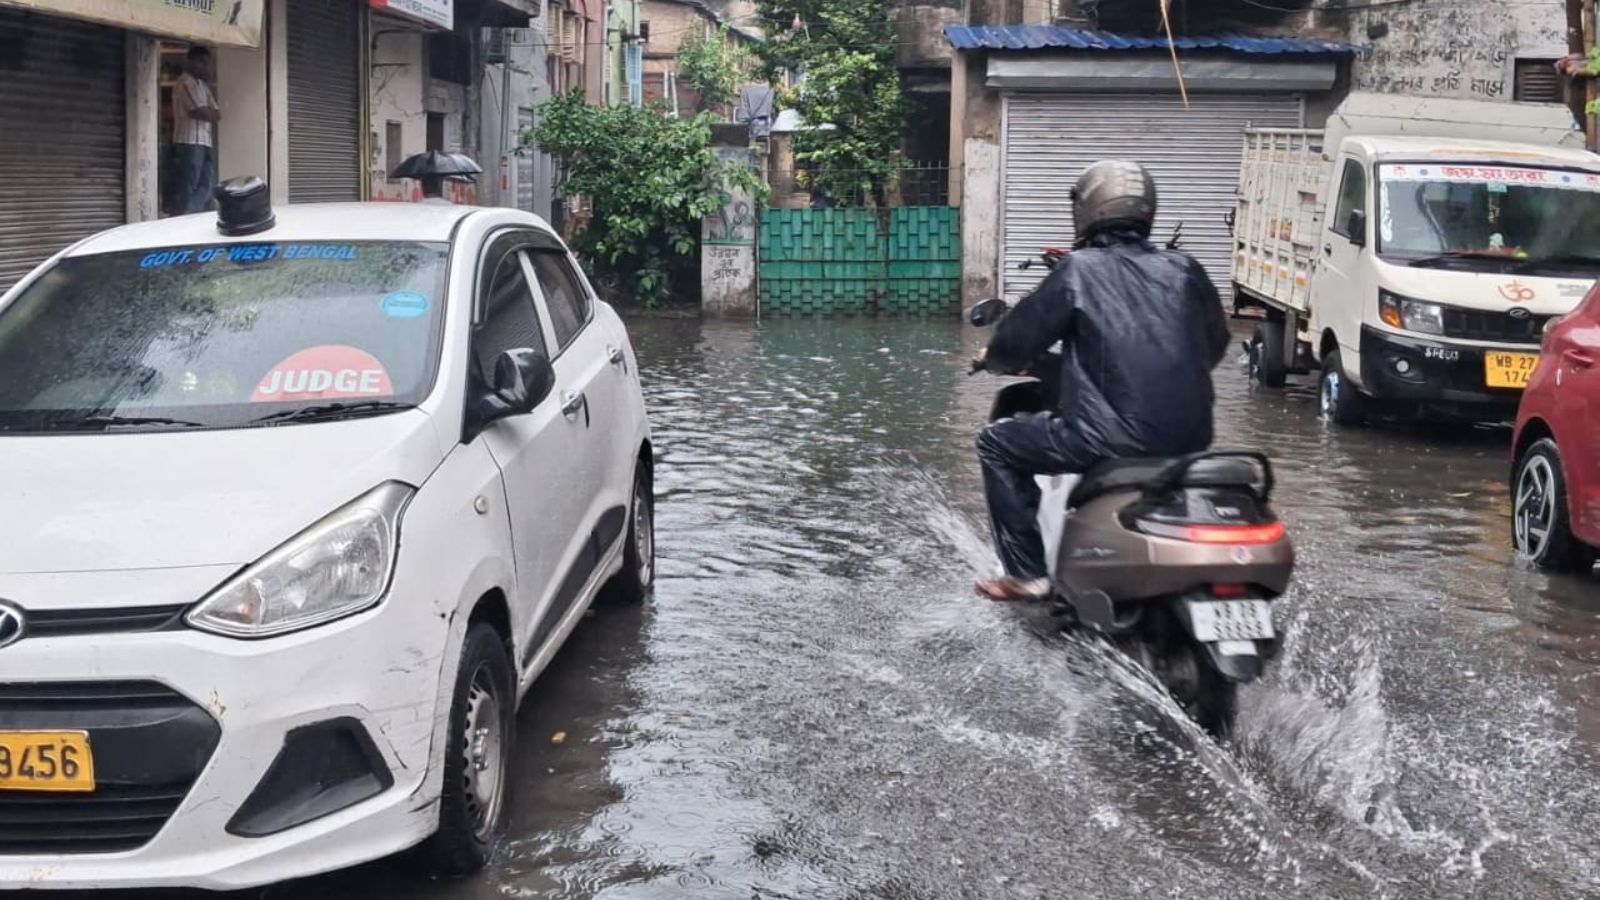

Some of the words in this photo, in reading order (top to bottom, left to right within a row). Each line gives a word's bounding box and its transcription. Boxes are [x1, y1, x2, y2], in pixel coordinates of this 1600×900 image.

[140, 251, 192, 269] GOVT.
[197, 248, 225, 263] OF
[226, 246, 280, 262] WEST
[282, 245, 358, 260] BENGAL
[1496, 355, 1512, 368] WB
[1520, 356, 1535, 370] 27
[259, 368, 384, 394] JUDGE
[1505, 371, 1529, 383] 174
